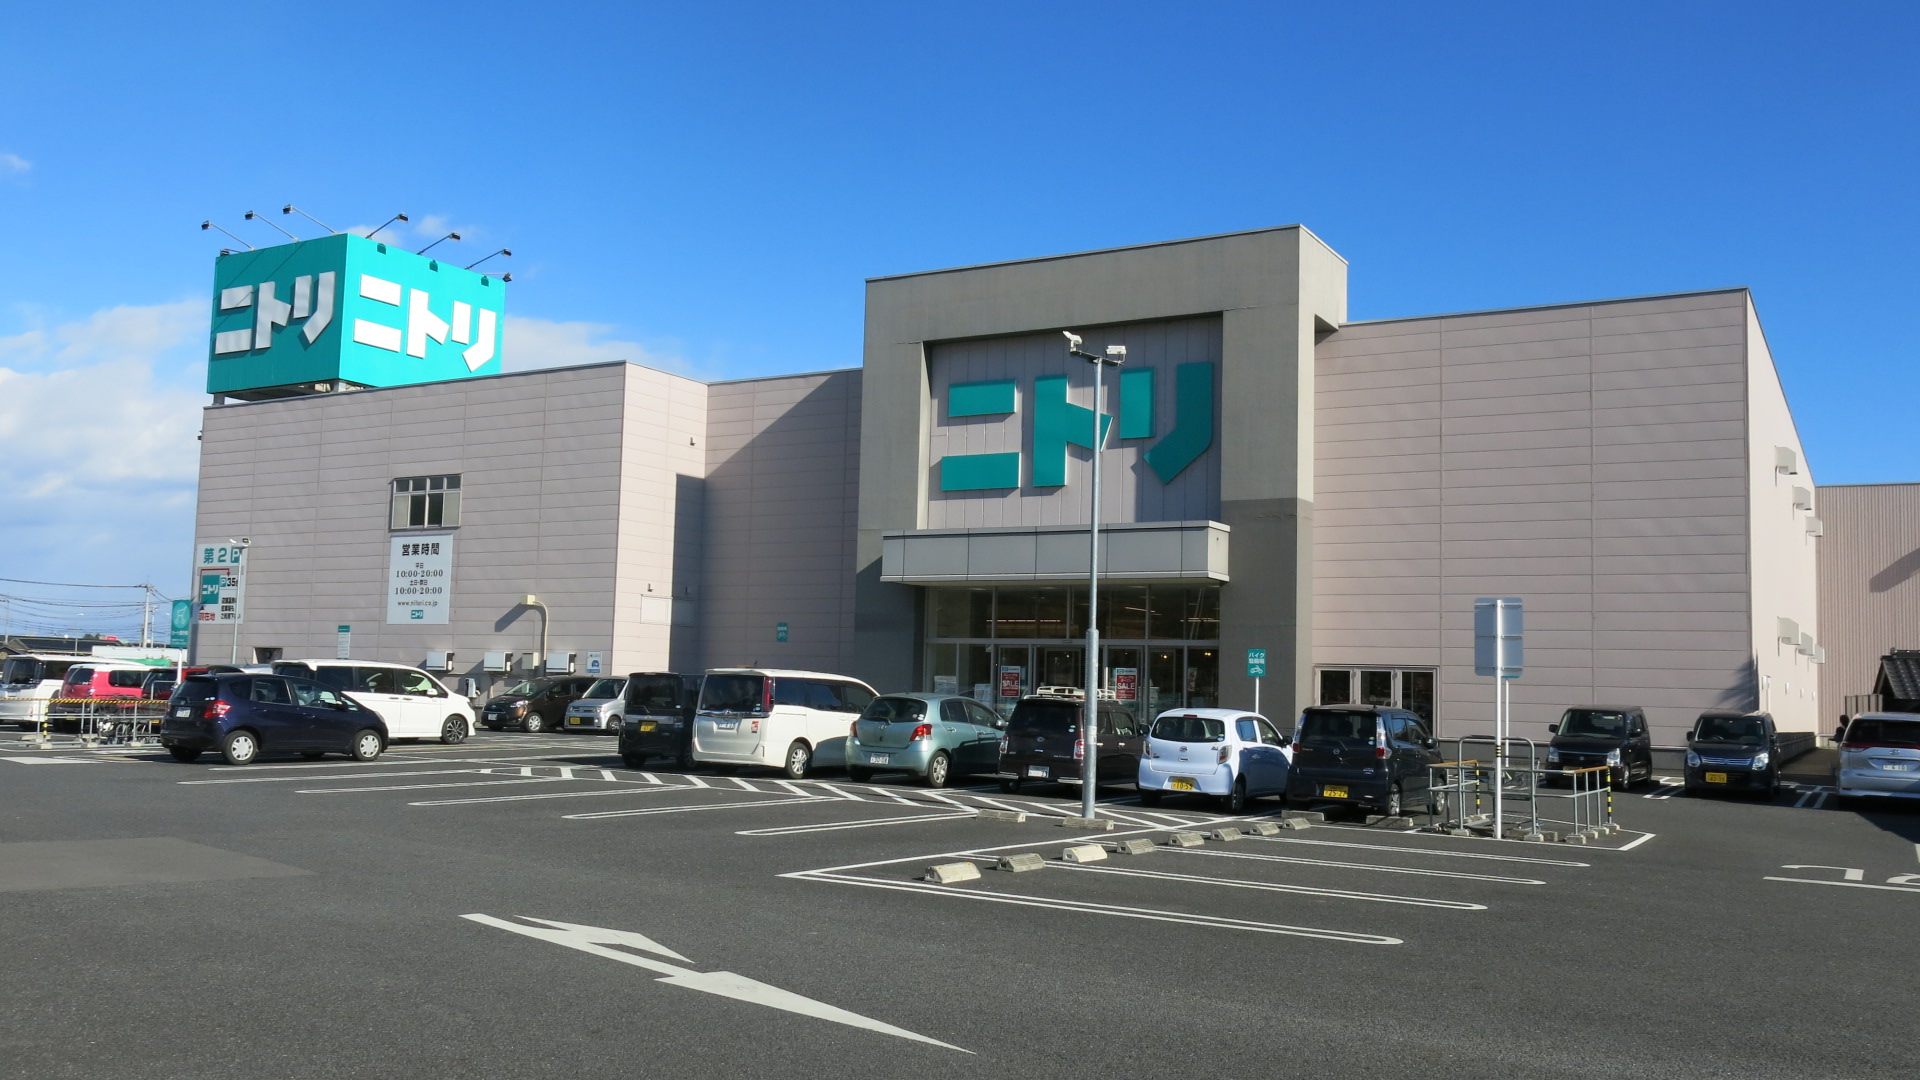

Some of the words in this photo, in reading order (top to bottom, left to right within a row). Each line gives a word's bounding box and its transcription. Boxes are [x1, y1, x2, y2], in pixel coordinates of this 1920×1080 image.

[214, 271, 336, 355] ニトリ
[353, 273, 497, 373] ニトリ
[941, 362, 1214, 492] ニトリ
[402, 542, 440, 556] 営業時間
[396, 569, 444, 578] 10:00-20:00
[202, 584, 219, 595] ニトリ
[395, 586, 443, 595] 10:00-20:00
[397, 599, 438, 607] www.nitori.co.jp
[1117, 682, 1135, 690] SALE
